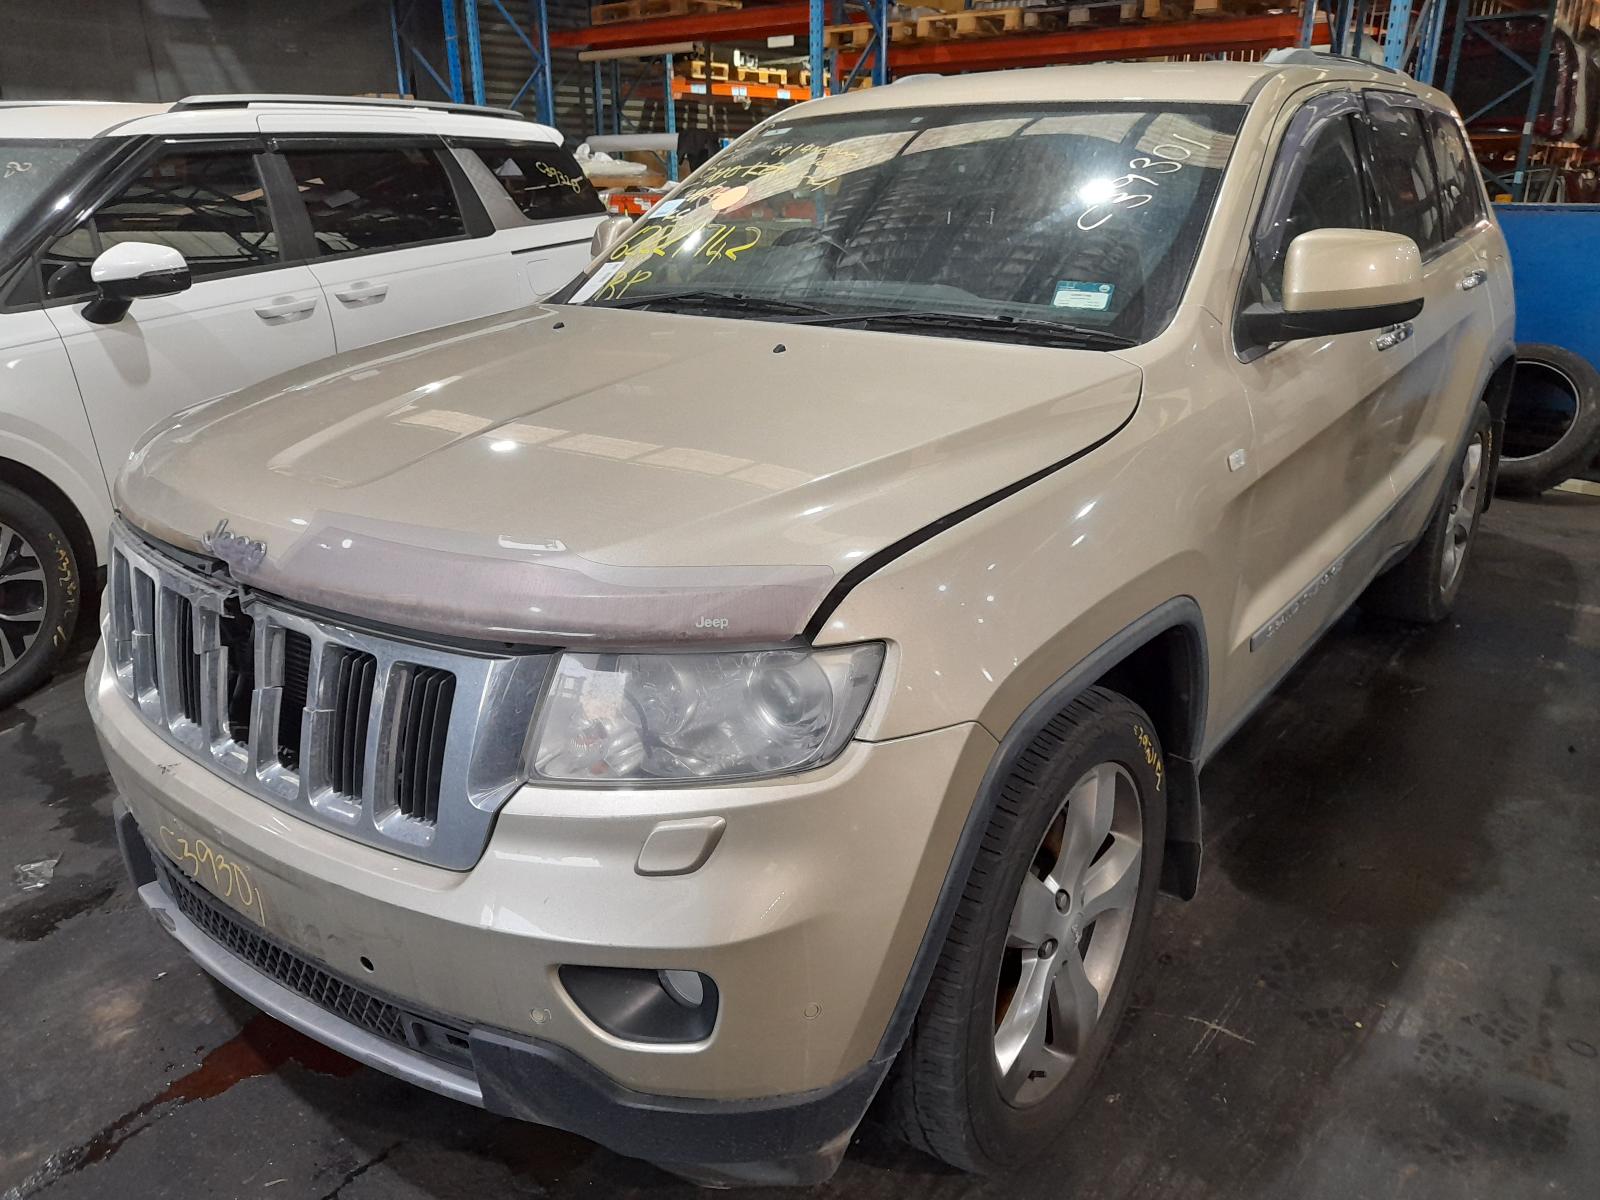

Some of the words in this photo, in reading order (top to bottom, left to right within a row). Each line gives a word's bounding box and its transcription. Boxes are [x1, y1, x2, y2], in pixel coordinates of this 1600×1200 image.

[1077, 133, 1211, 231] C39301
[695, 615, 729, 630] Jeep
[160, 825, 266, 928] C39301
